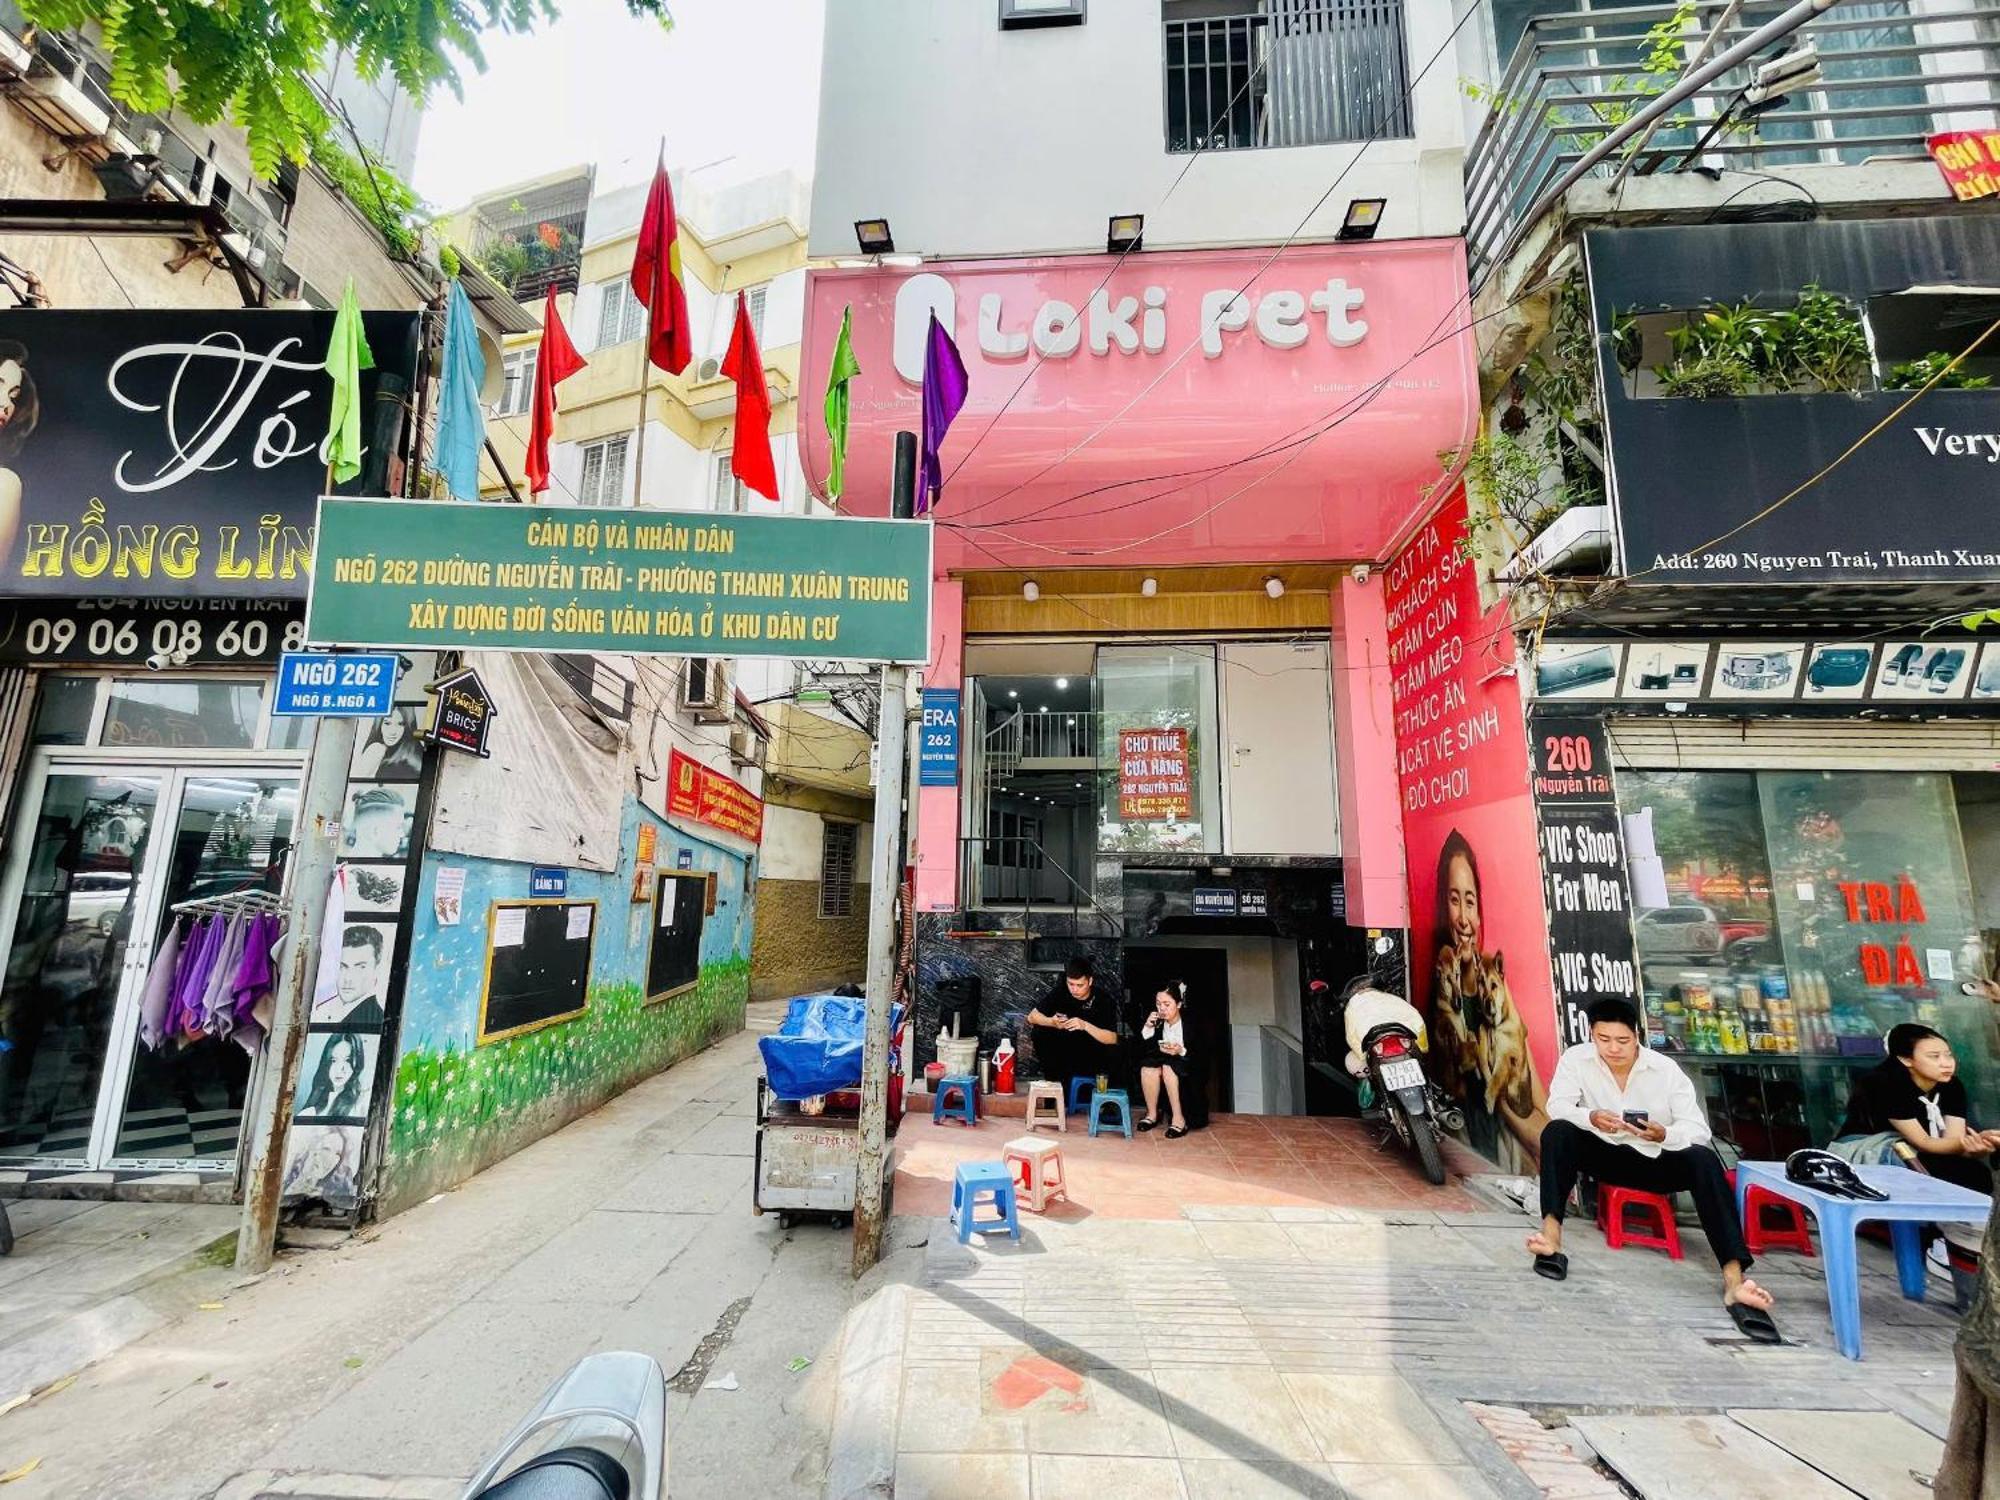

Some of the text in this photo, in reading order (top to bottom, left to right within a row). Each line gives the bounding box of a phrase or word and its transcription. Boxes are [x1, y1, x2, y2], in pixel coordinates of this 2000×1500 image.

[978, 286, 1166, 358] Loki
[1913, 427, 2000, 463] Very
[21, 497, 200, 578] HỒNG
[528, 517, 735, 555] CÁN BỘ VÀ NHÂN DÂN
[335, 553, 377, 584] NGÕ
[381, 559, 418, 585] 262
[424, 553, 490, 587] ĐƯỜNG
[496, 556, 575, 590] NGUYỄN
[580, 560, 624, 591] TRÃI
[638, 561, 716, 595] PHƯỜNG
[721, 572, 785, 597] THANH
[791, 570, 842, 599] XUÂN
[848, 576, 910, 602] TRUNG
[1653, 553, 1699, 570] Add:
[1704, 553, 1738, 570] 260
[1742, 553, 1823, 572] Nguyen
[1827, 551, 1878, 571] Trai,
[1881, 550, 1950, 568] Thanh
[26, 618, 77, 655] 09
[88, 618, 139, 656] 06
[152, 619, 202, 657] 08
[215, 620, 268, 657] 60
[409, 597, 840, 641] XÂY DỰNG ĐỜI SỐNG VĂN HÓA Ở KHU DÂN CƯ
[293, 659, 381, 686] NGÕ 262
[292, 691, 319, 707] NGÕ
[366, 695, 376, 708] A
[923, 708, 957, 727] ERA
[1402, 677, 1467, 736] THỨC ĂN
[446, 710, 477, 732] BRICS
[927, 734, 952, 746] 262
[1433, 727, 1455, 763] VỆ
[1458, 706, 1500, 752] SINH
[1125, 735, 1149, 753] CHO
[1545, 735, 1593, 772] 260
[1151, 757, 1184, 776] HÀNG
[1431, 767, 1470, 804] CHƠI
[1545, 825, 1618, 868] VIC Shop
[1552, 873, 1622, 912] For Men
[1836, 872, 1929, 925] TRÀ
[1560, 952, 1635, 998] VIC Shop
[1859, 931, 1927, 989] ĐÁ
